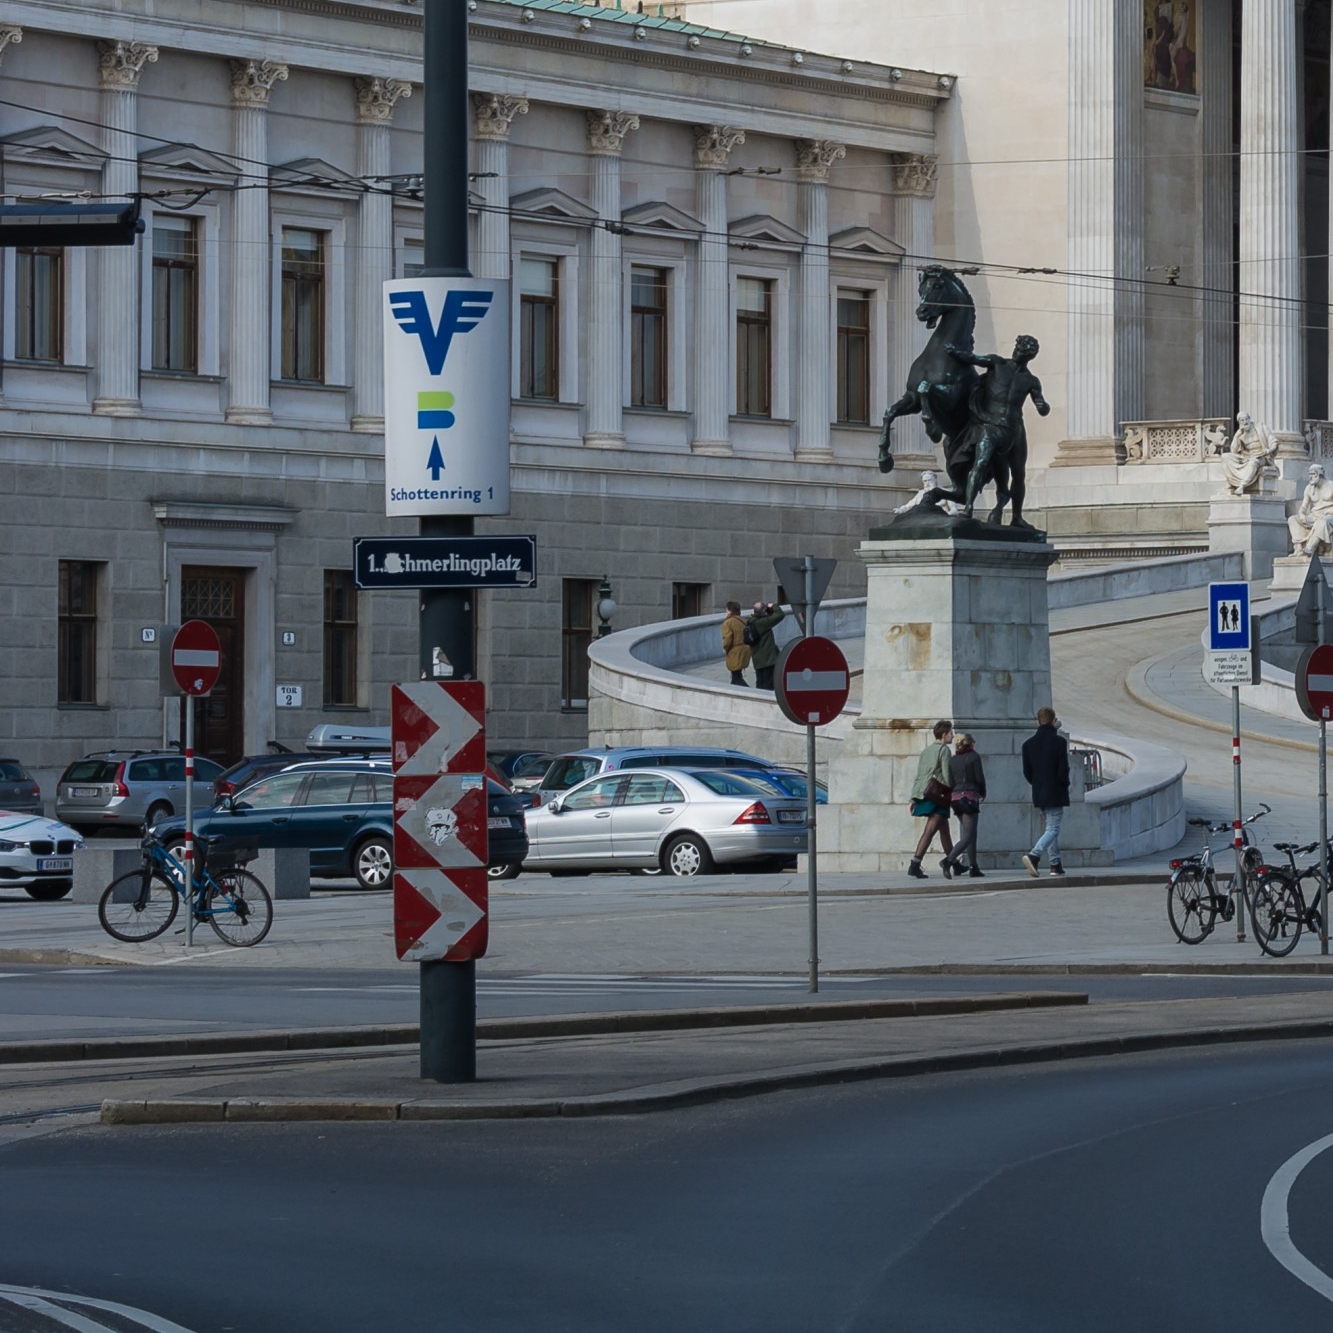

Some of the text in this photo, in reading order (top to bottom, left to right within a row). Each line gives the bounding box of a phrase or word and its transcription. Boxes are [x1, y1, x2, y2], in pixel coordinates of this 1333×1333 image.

[390, 486, 494, 504] Schottenring 1
[385, 553, 521, 577] chmerlingplatz
[281, 687, 298, 695] TOR
[285, 695, 293, 706] 2
